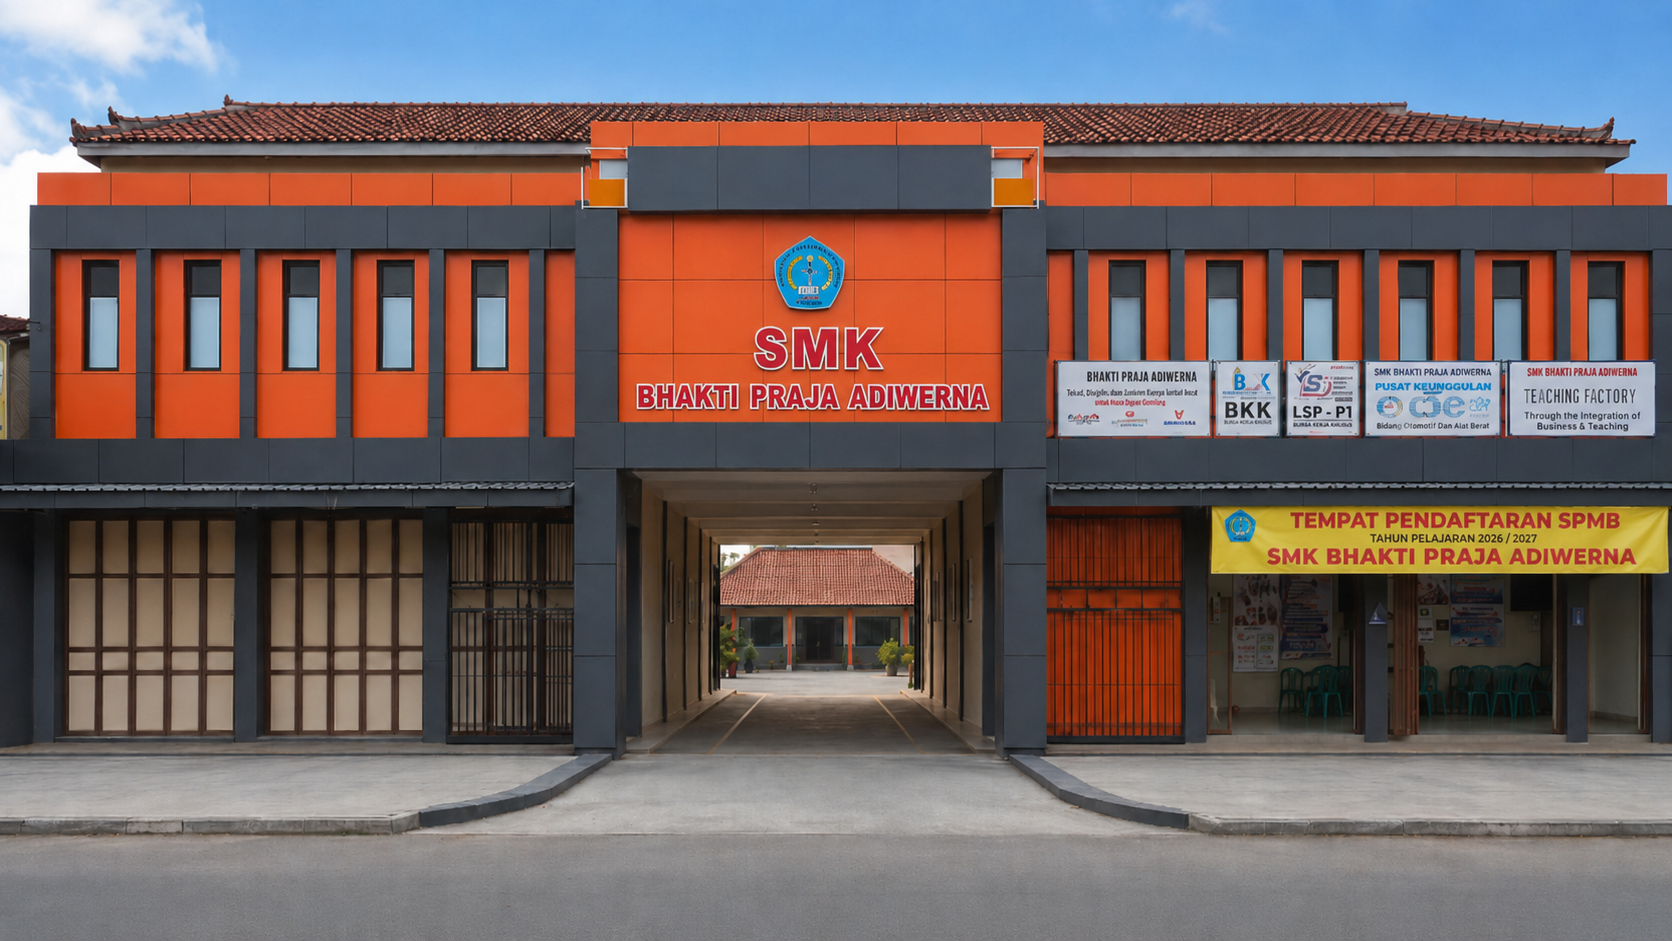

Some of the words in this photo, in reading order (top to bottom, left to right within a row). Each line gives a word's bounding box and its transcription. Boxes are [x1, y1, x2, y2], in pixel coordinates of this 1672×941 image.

[753, 325, 884, 371] SMK
[1086, 371, 1119, 383] BHAKTI
[1121, 371, 1149, 383] PRAJA
[1151, 371, 1197, 383] ADIWERNA
[1374, 368, 1392, 376] SMK
[1393, 368, 1422, 376] BHAKTI
[1424, 368, 1449, 376] PRAJA
[1450, 368, 1492, 376] ADIWERNA
[1526, 367, 1544, 377] SMK
[1545, 367, 1572, 377] BHAKTI
[1573, 367, 1597, 377] PRAJA
[1598, 367, 1638, 377] ADIWERNA
[1375, 382, 1411, 391] PUSAT
[1413, 382, 1492, 392] KEUNGGULAN
[636, 383, 739, 410] BHAKTI
[749, 383, 840, 410] PRAJA
[847, 383, 990, 411] ADIWERNA
[1524, 388, 1580, 404] TEACHING
[1584, 388, 1636, 404] FACTORY
[1225, 402, 1272, 419] BKK
[1293, 405, 1323, 419] LSP
[1335, 405, 1352, 419] P1
[1524, 411, 1562, 422] Through
[1563, 411, 1578, 420] the
[1580, 411, 1630, 422] Integration
[1631, 411, 1641, 420] of
[1376, 422, 1402, 431] Bidang
[1403, 422, 1436, 430] Otomotif
[1536, 422, 1577, 431] Business
[1579, 422, 1586, 431] &
[1588, 422, 1629, 432] Teaching
[1290, 512, 1379, 529] TEMPAT
[1385, 512, 1552, 529] PENDAFTARAN
[1558, 512, 1621, 529] SPMB
[1370, 533, 1408, 543] TAHUN
[1411, 533, 1475, 543] PELAJARAN
[1478, 533, 1503, 543] 2026
[1505, 532, 1511, 544] /
[1512, 533, 1538, 543] 2027
[1267, 547, 1319, 565] SMK
[1326, 548, 1415, 565] BHAKTI
[1424, 548, 1502, 565] PRAJA
[1508, 548, 1637, 565] ADIWERNA
